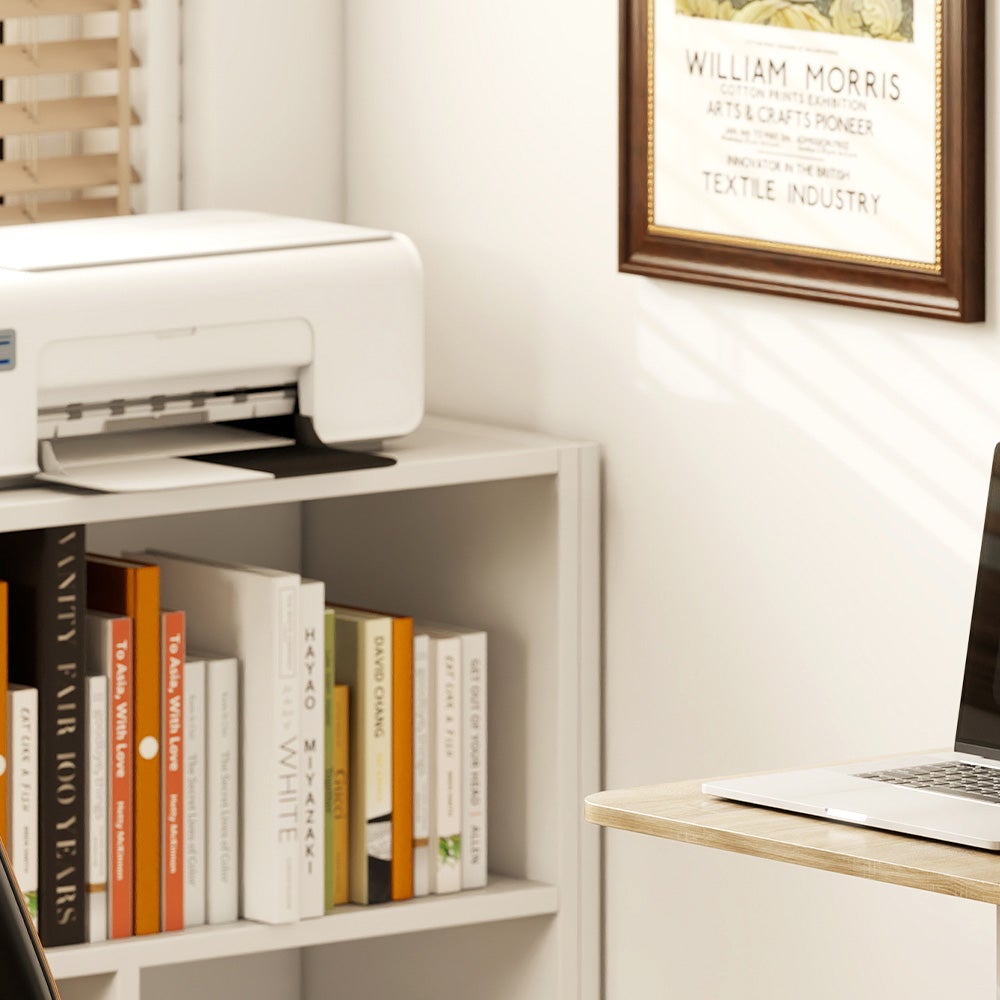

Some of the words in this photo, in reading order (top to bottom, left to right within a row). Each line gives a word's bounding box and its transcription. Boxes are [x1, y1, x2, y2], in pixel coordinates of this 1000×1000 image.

[686, 49, 788, 87] WILLIAM
[805, 63, 901, 101] MORRIS
[719, 83, 765, 98] COTTON
[768, 89, 804, 105] PRINTS
[808, 94, 867, 112] EXHIBITION
[706, 100, 742, 120] ARTS
[745, 104, 754, 121] &
[757, 106, 811, 128] CRAFTS
[815, 113, 874, 136] PIONEER
[702, 170, 776, 202] TEXTILE
[787, 183, 881, 215] INDUSTRY
[57, 530, 77, 643] VANITY
[115, 640, 128, 661] To
[168, 634, 180, 655] To
[373, 635, 385, 683] DAVID
[113, 663, 128, 700] Asia,
[166, 656, 180, 694] Asia,
[304, 628, 317, 711] HAYAO
[469, 657, 481, 682] GET
[57, 661, 77, 736] FAIR
[168, 695, 180, 734] With
[373, 685, 385, 739] CHANG
[115, 701, 128, 741] With
[115, 743, 128, 779] Love
[168, 736, 180, 772] Love
[278, 735, 298, 844] WHITE
[303, 738, 317, 875] MIYAZAKI
[56, 814, 77, 926] YEARS
